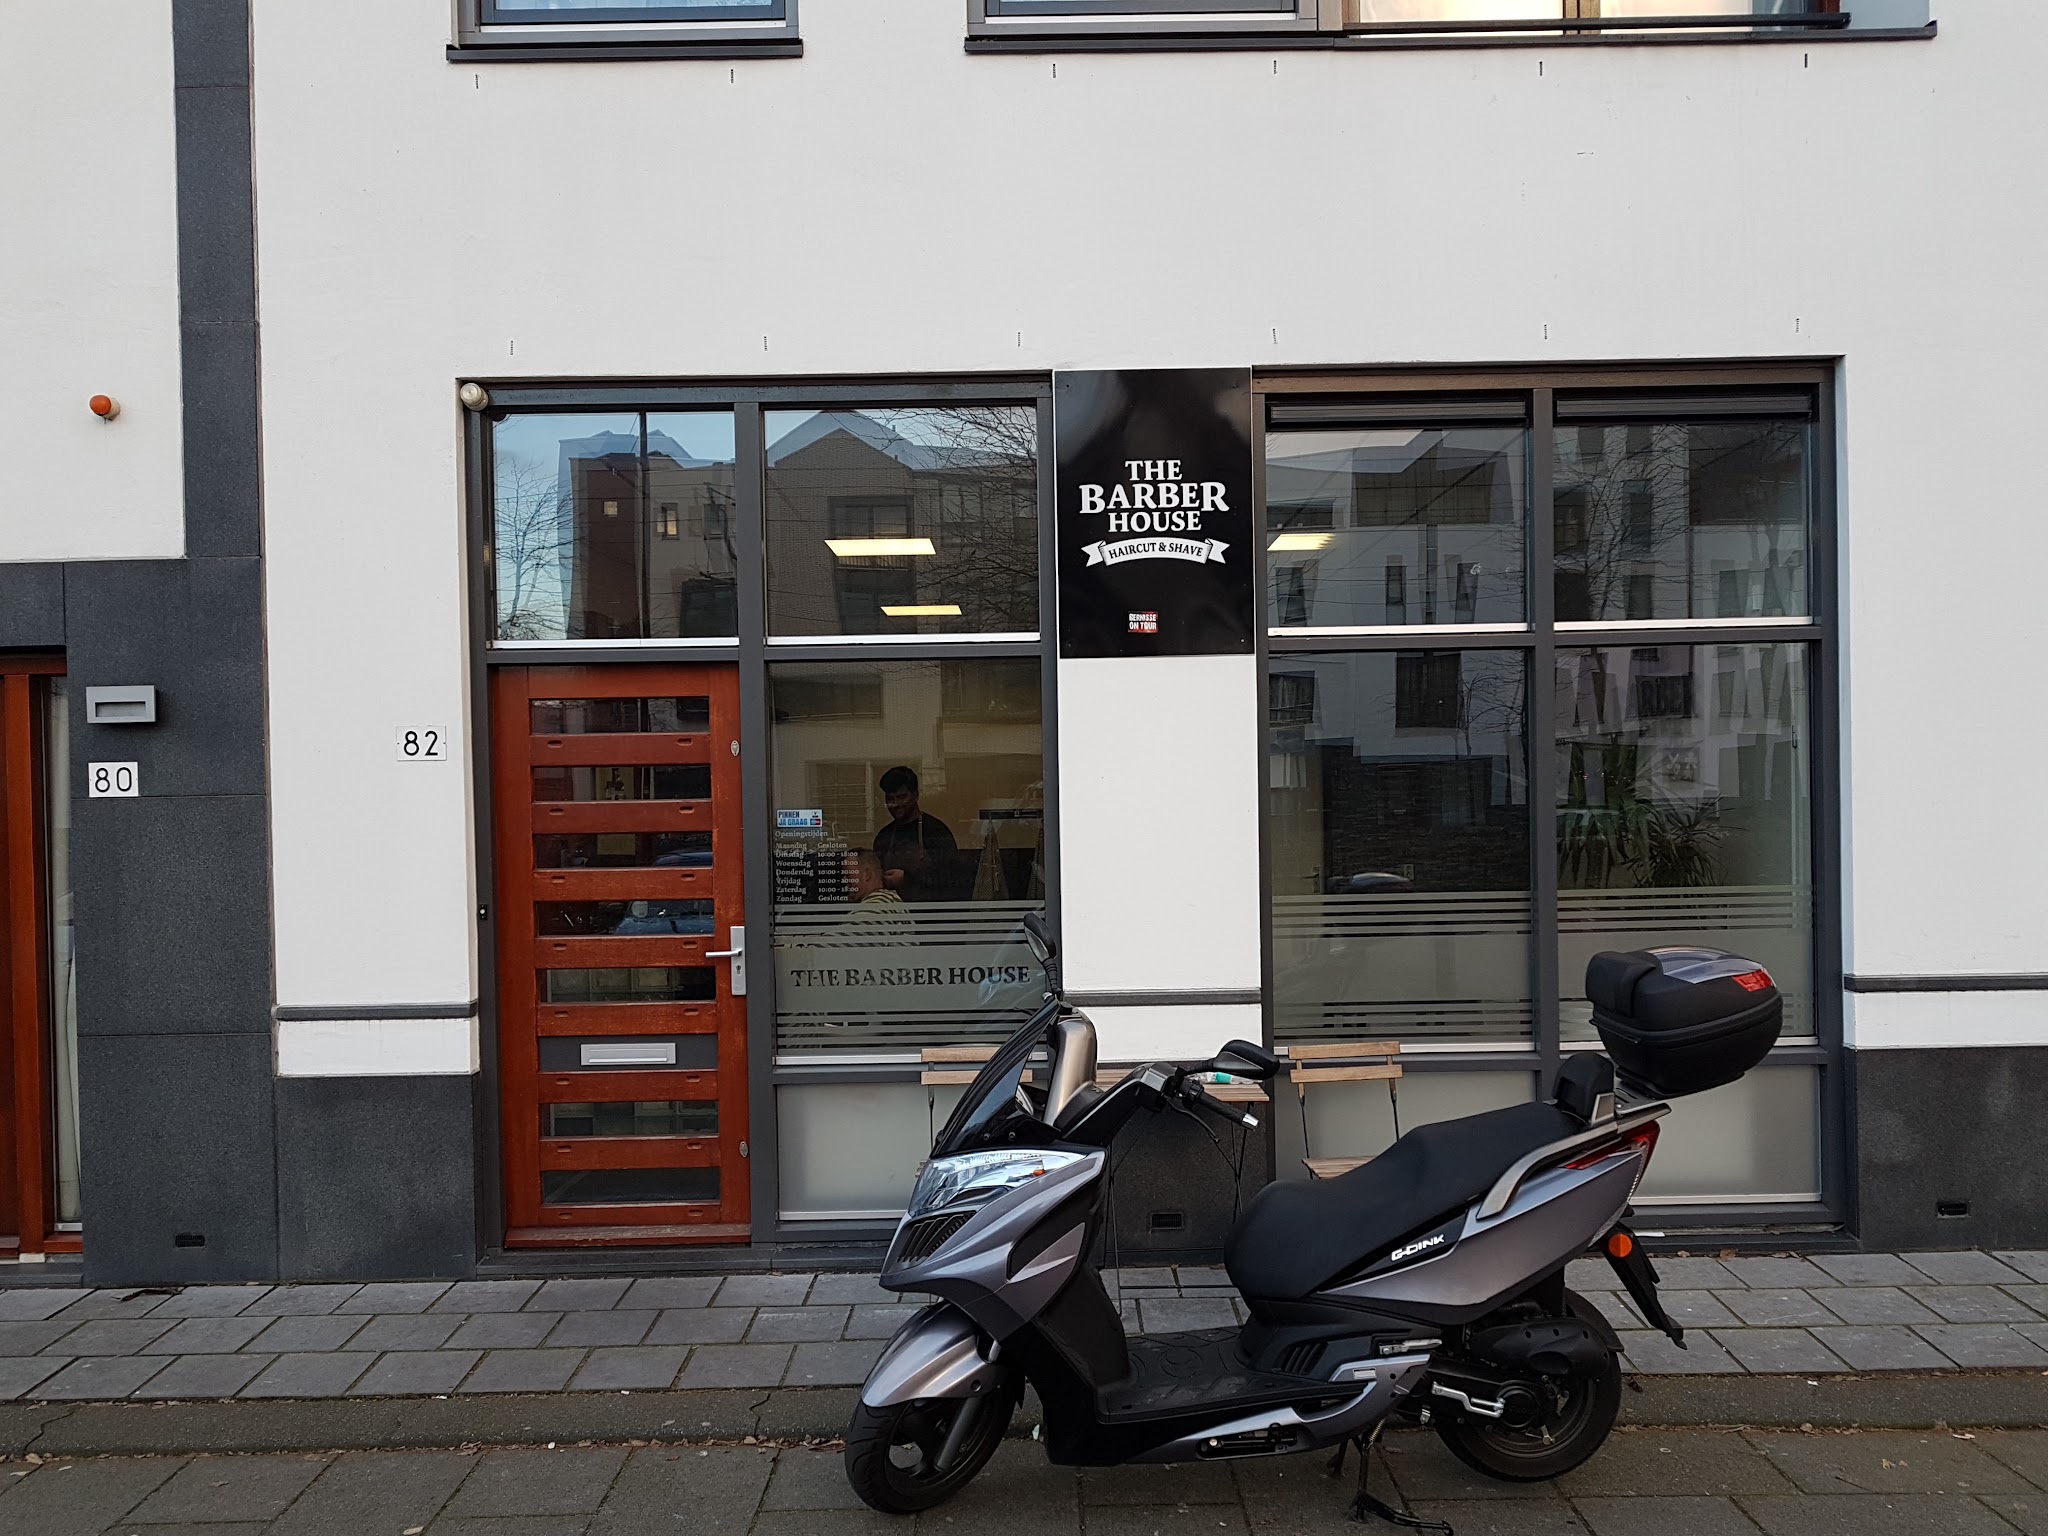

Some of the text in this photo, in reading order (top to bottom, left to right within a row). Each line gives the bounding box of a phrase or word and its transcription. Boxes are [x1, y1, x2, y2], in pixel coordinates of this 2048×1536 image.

[1125, 459, 1182, 481] THE
[1079, 481, 1230, 514] BARBER
[1108, 510, 1201, 533] HOUSE
[1108, 542, 1203, 559] HAIRCUT & SHAVE
[1129, 622, 1157, 630] ON TOUR
[404, 730, 438, 756] 82
[95, 767, 132, 793] 80
[775, 842, 807, 850] Maandag
[775, 860, 811, 868] Woensdag
[775, 869, 814, 877] Donderdag
[775, 877, 801, 886] Vrijdag
[776, 886, 806, 894] Zaterdag
[776, 895, 802, 903] Zondag
[791, 966, 1031, 987] THE BARBER HOUSE
[1391, 1234, 1445, 1261] G-DINK
